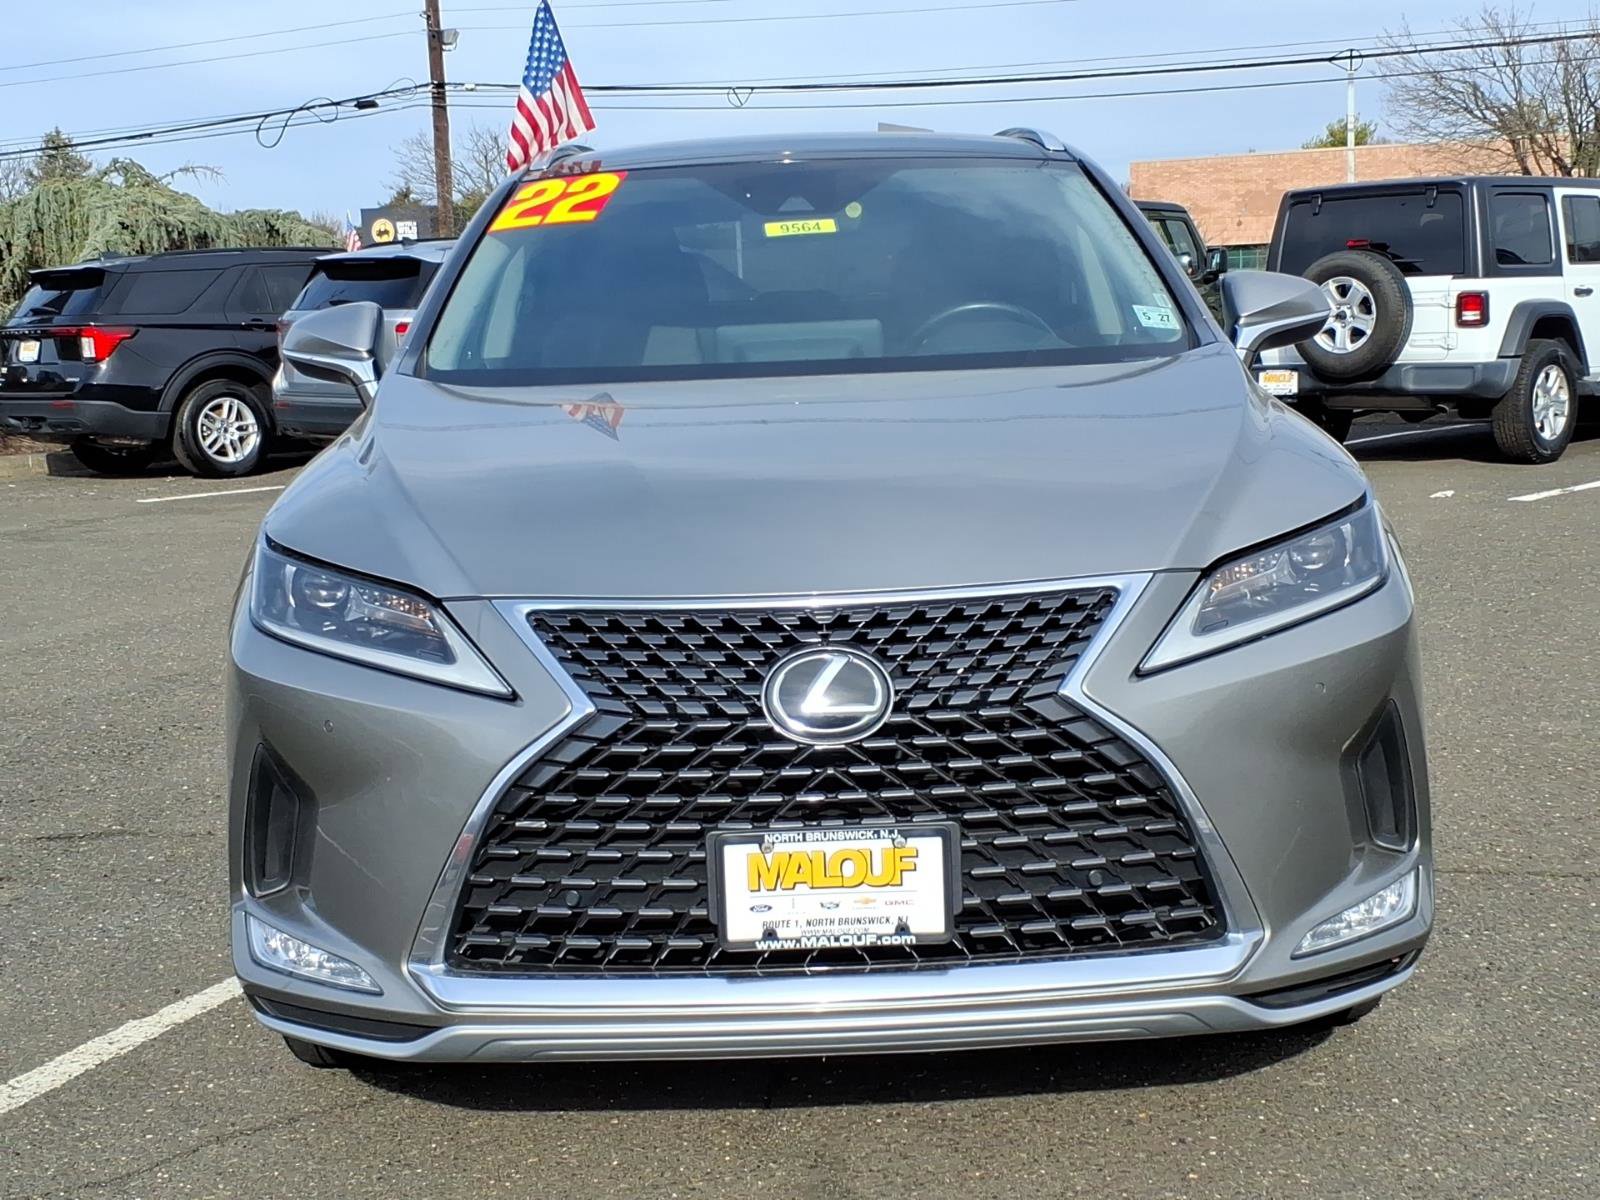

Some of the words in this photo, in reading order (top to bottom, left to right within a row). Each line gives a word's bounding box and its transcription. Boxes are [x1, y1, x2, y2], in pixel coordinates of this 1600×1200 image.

[488, 172, 620, 232] 22
[780, 222, 821, 233] 9564
[1142, 312, 1151, 321] 5
[1158, 313, 1170, 322] 27
[764, 832, 802, 843] NORTH
[805, 830, 878, 842] BRUNSWICK,
[880, 829, 901, 839] N.J.
[747, 848, 918, 892] MALOUF
[762, 920, 791, 929] ROUTE
[806, 917, 836, 927] NORTH
[838, 915, 894, 926] BRUNSWICK,
[755, 933, 916, 950] www.MALOUF.com
